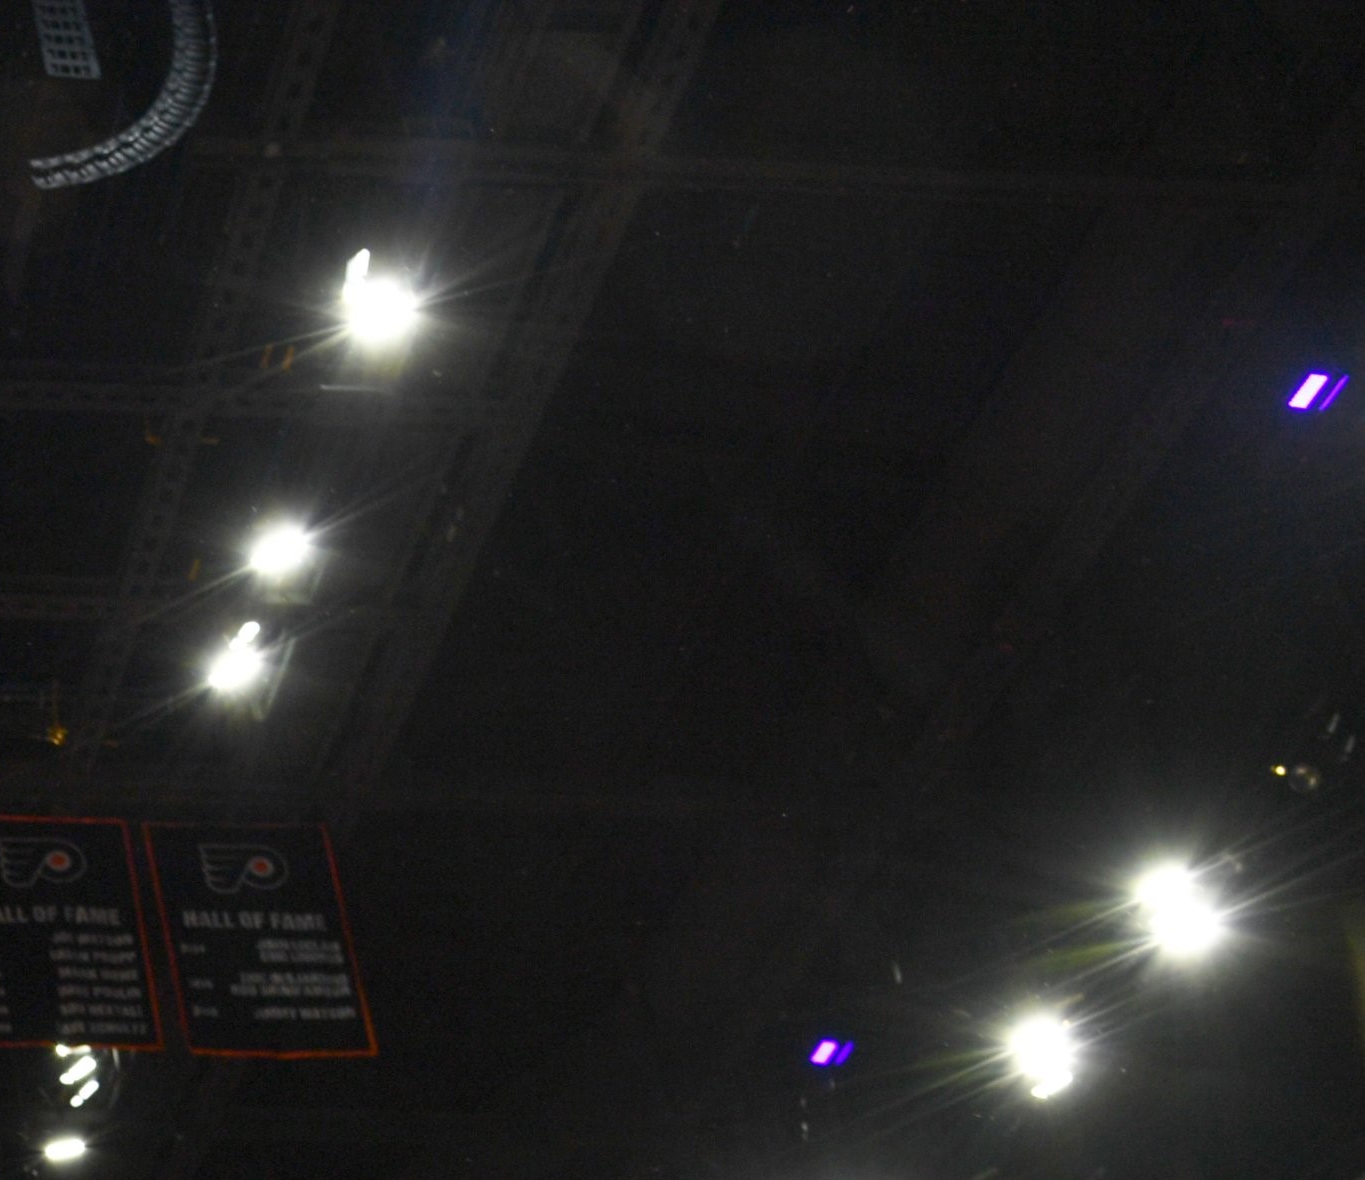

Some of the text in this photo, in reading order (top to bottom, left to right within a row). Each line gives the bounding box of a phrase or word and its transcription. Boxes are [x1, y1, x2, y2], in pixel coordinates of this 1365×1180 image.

[32, 904, 58, 923] OF
[63, 905, 121, 927] FAME
[181, 909, 328, 933] HALL OF FAME
